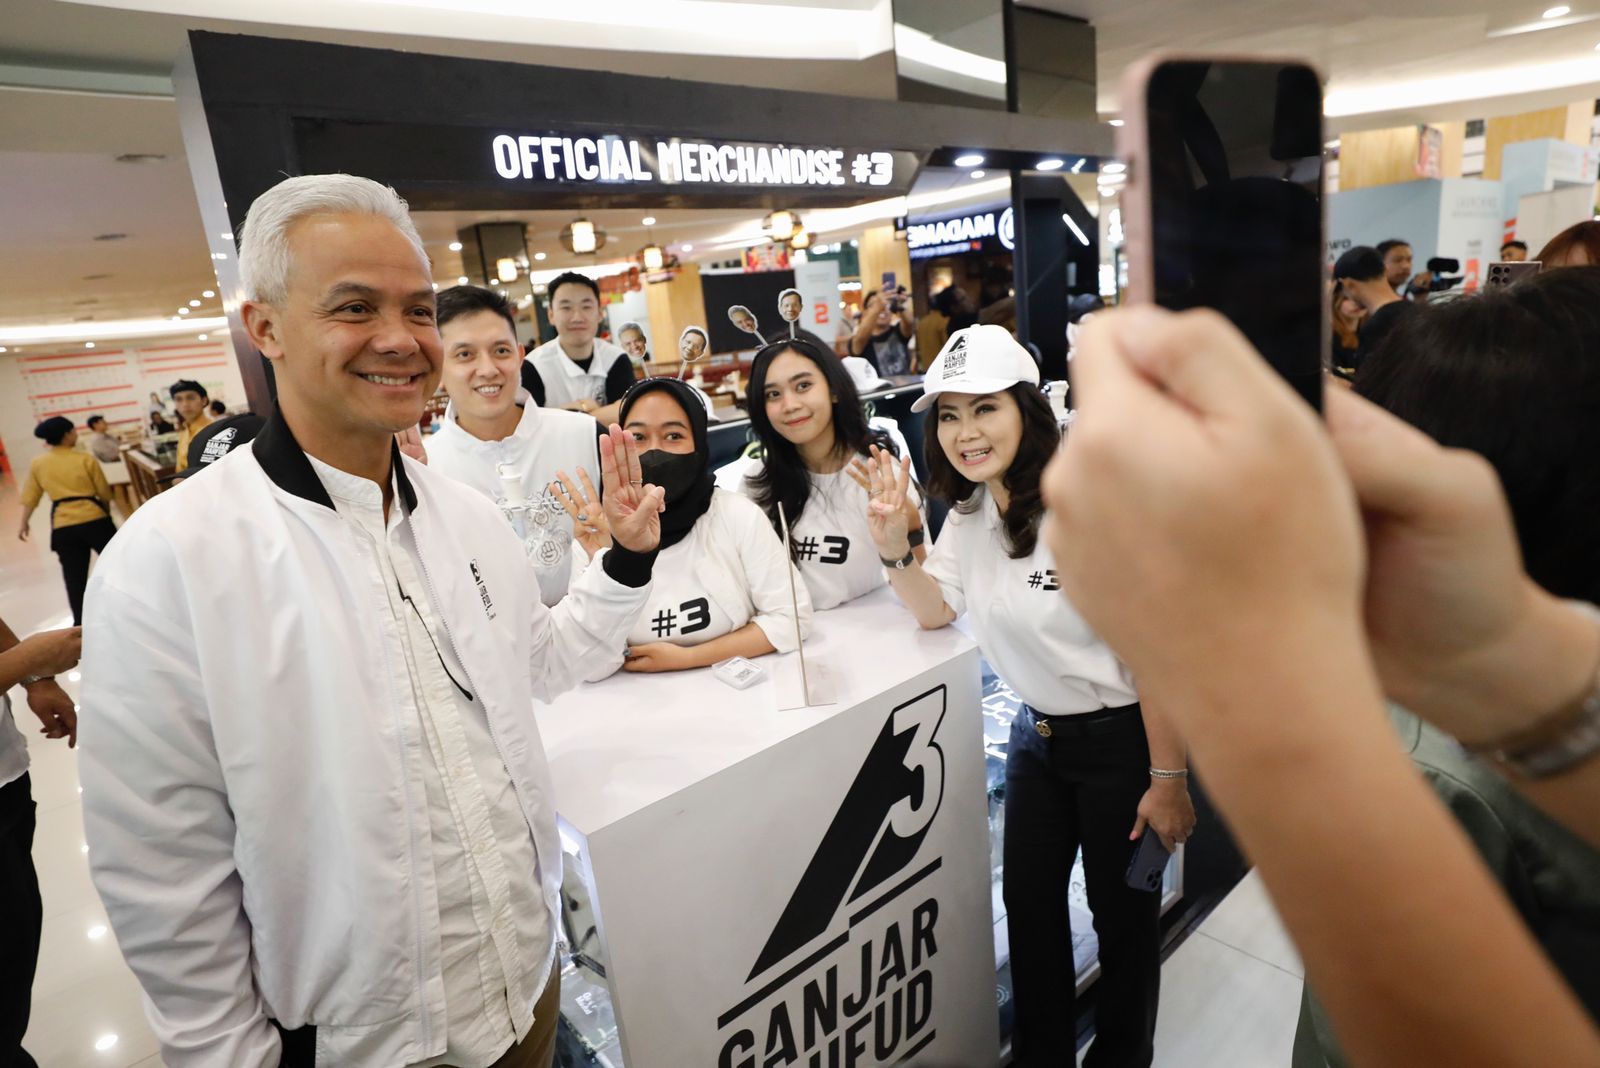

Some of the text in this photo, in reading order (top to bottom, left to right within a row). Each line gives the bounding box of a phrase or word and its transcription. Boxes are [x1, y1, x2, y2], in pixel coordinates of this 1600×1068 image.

[492, 134, 893, 187] OFFICIAL MERCHANDISE #3
[797, 535, 850, 566] #3
[1027, 569, 1062, 591] #3
[651, 597, 711, 638] #3
[718, 897, 939, 1068] GANJAR
